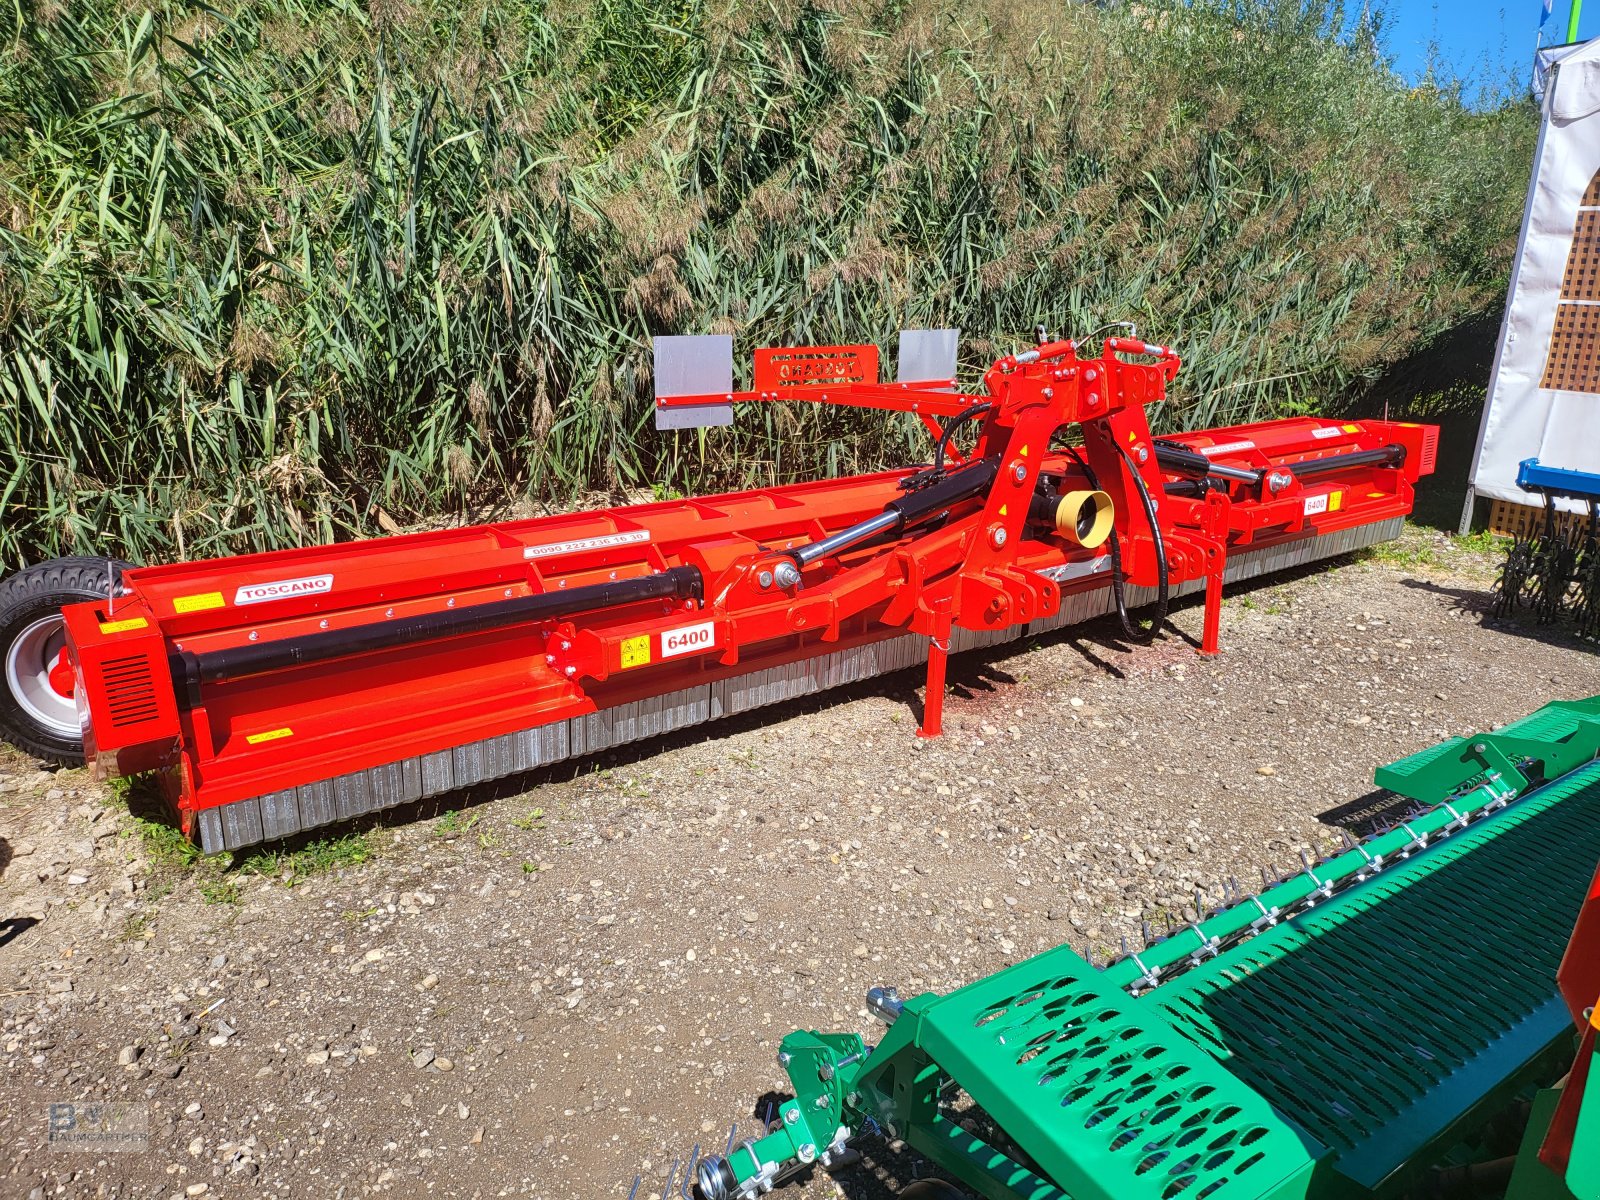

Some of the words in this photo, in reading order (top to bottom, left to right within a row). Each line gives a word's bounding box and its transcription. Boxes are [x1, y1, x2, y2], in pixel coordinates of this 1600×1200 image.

[1307, 499, 1325, 511] 6400
[242, 579, 326, 598] TOSCANO
[667, 629, 709, 650] 6400
